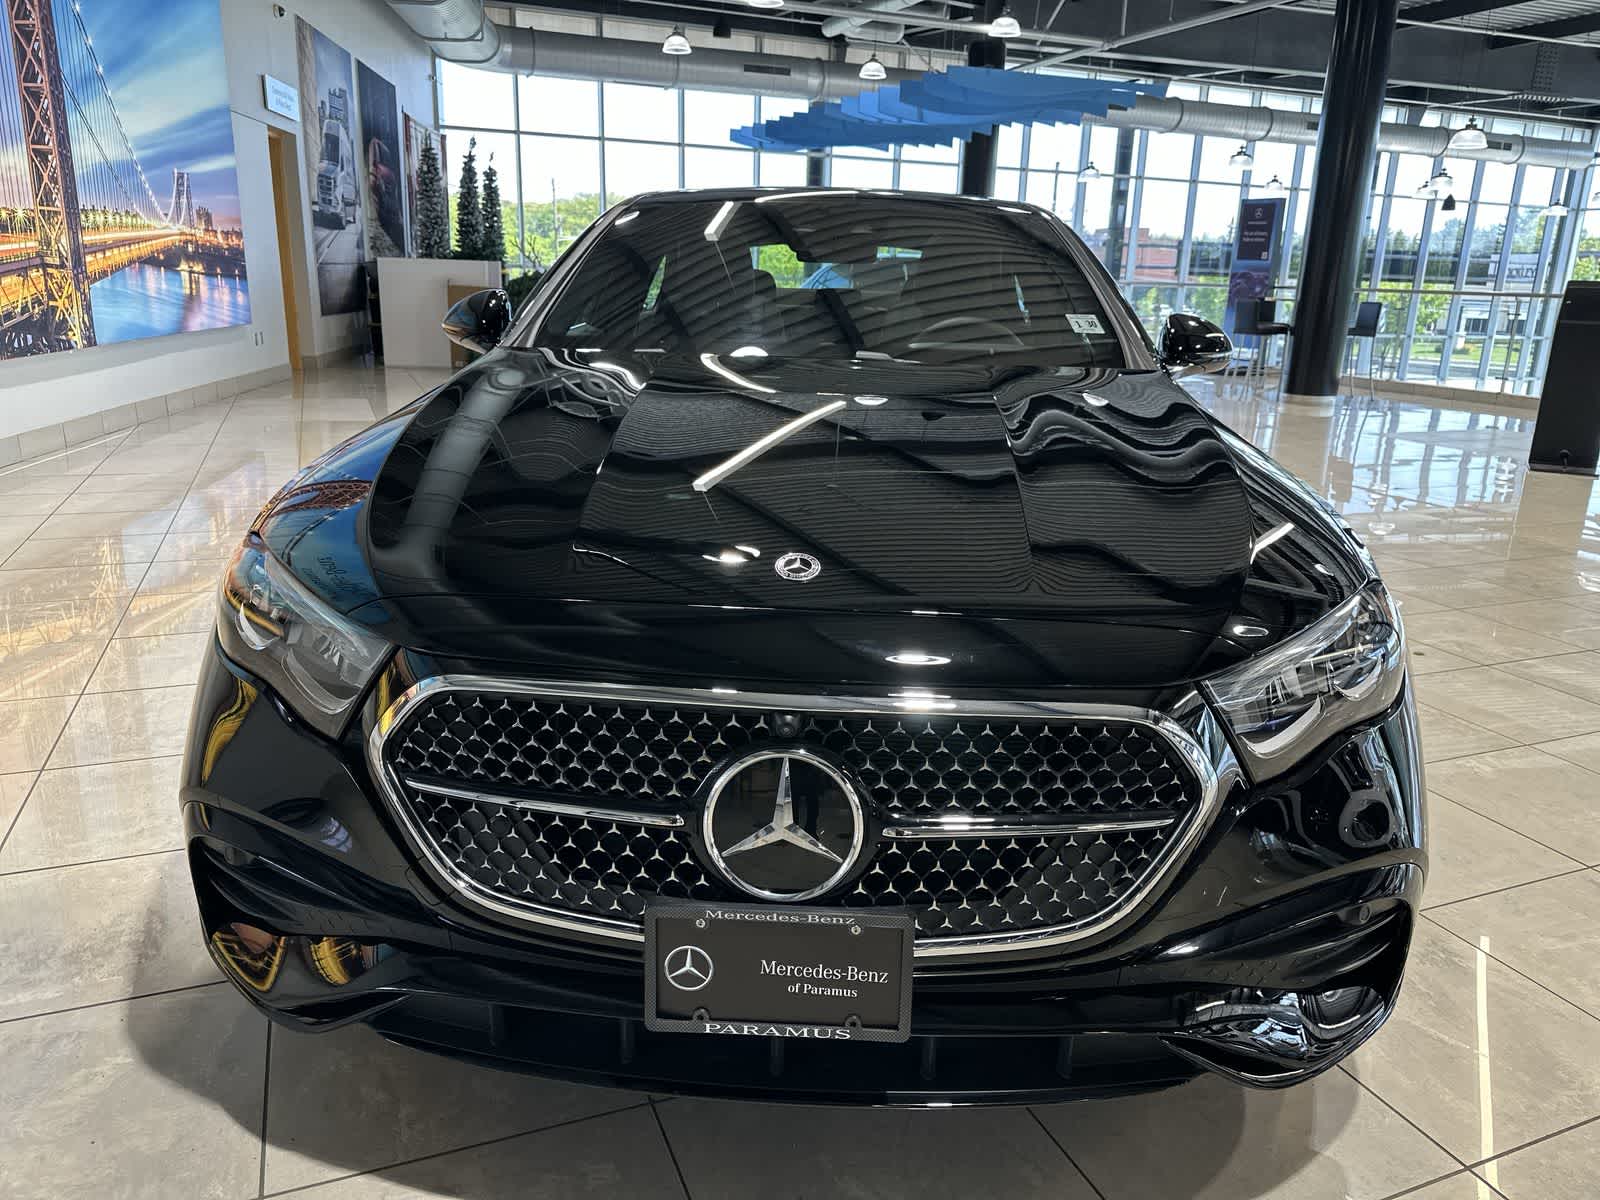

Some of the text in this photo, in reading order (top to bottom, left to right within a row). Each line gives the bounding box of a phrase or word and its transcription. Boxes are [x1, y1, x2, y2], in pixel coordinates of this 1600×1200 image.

[705, 910, 856, 924] Mercedes-Benz
[760, 959, 889, 984] Mercedes-Benz
[787, 982, 858, 998] of Paramus
[704, 1023, 851, 1039] PARAMUS
